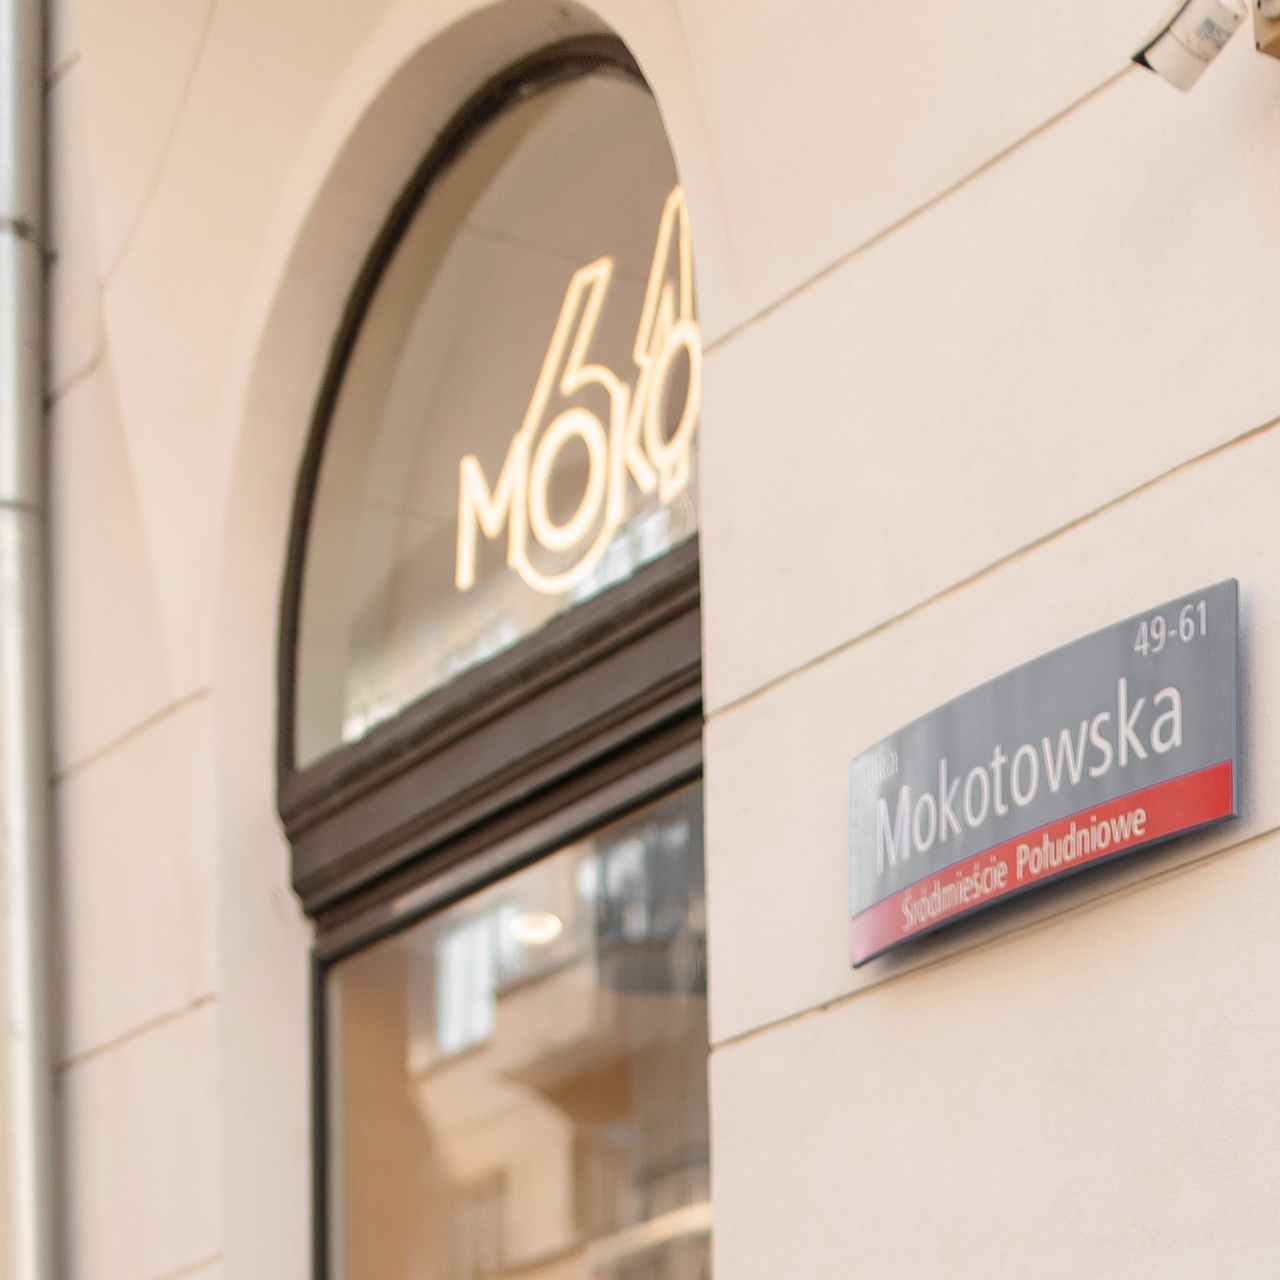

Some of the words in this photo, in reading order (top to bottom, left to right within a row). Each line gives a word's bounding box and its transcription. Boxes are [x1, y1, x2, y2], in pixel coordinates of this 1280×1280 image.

[1133, 599, 1207, 657] 49-61
[876, 677, 1183, 874] Mokotowska
[1015, 807, 1147, 880] Południowe
